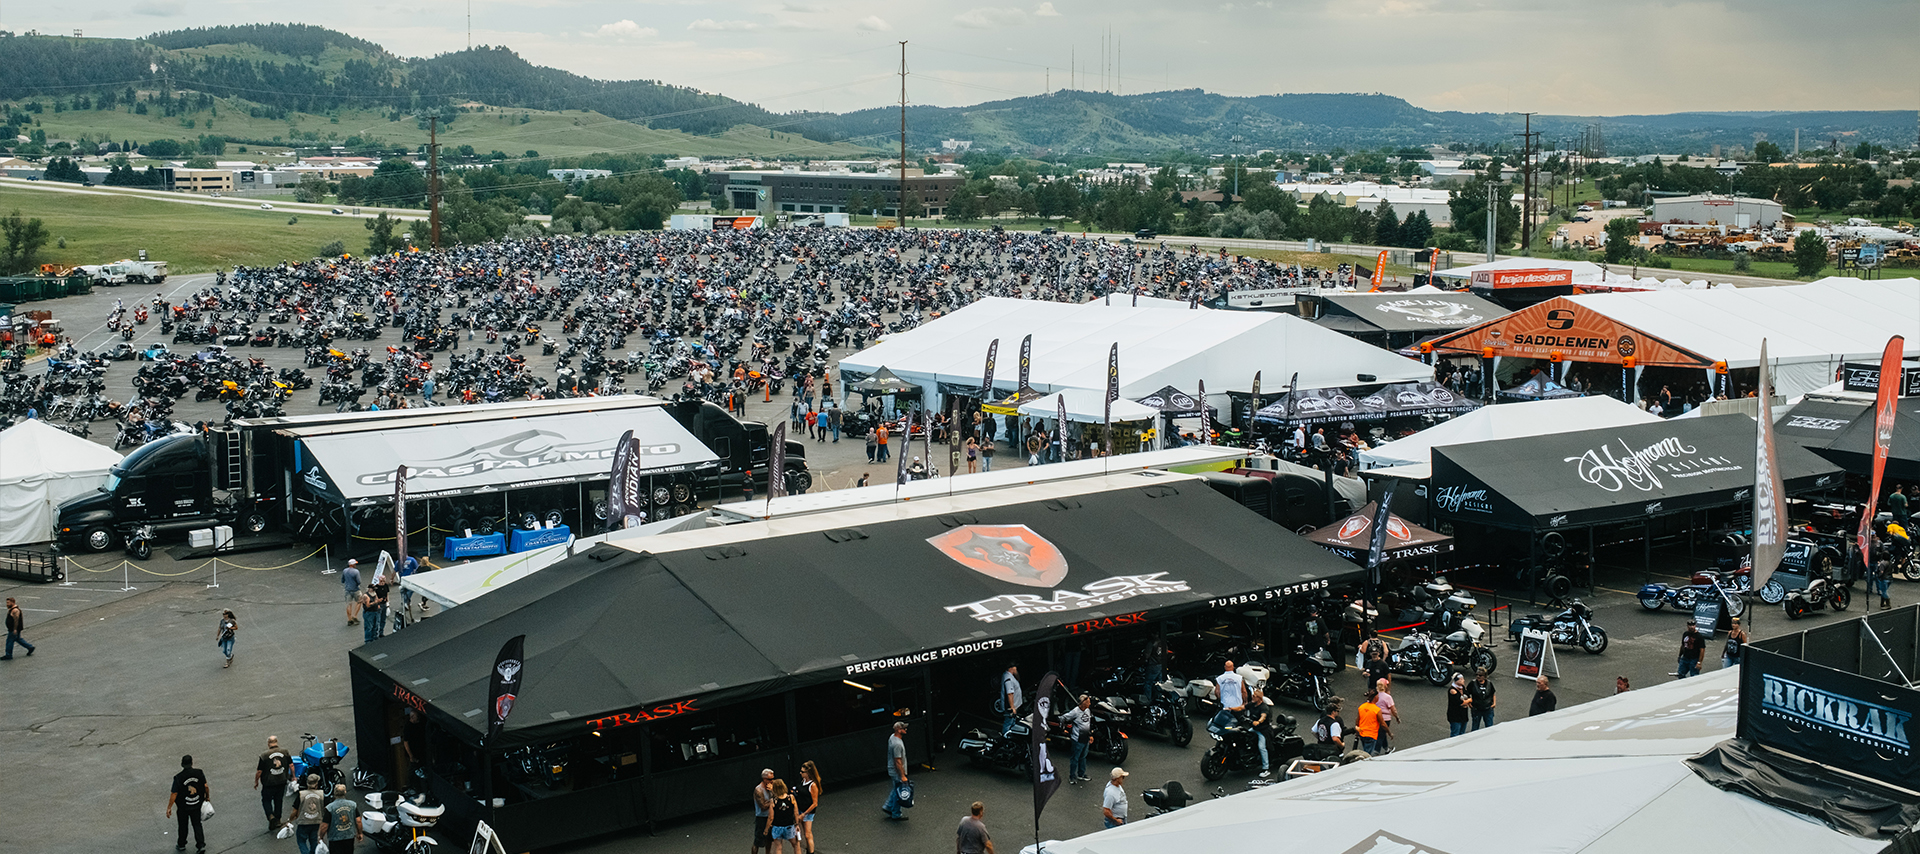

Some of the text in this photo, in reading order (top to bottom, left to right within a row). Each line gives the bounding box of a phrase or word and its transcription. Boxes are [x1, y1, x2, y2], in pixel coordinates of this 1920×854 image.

[1500, 273, 1566, 285] baja designs
[1514, 334, 1610, 349] SADDLEMEN
[984, 369, 993, 391] WILD
[1020, 366, 1028, 389] WILD
[1110, 376, 1118, 399] WILD
[361, 455, 547, 484] COASTAL
[1563, 436, 1697, 492] Hofmann
[1657, 456, 1731, 472] DESIGNS
[629, 451, 639, 508] INDIAN
[1435, 484, 1488, 512] Hofmann
[1464, 501, 1493, 510] DESIGNS
[1393, 545, 1439, 559] TRASK
[945, 572, 1187, 613] TRASK
[977, 583, 1191, 623] TURBO SYSTEMS
[1208, 579, 1329, 608] TURBO SYSTEMS
[1065, 611, 1149, 635] TRASK
[846, 639, 1003, 675] PERFORMANCE PRODUCTS
[392, 682, 428, 713] TRASK
[1762, 678, 1910, 744] RICKRAK
[586, 698, 700, 731] TRASK
[1762, 709, 1823, 732] MOTORCYCLE
[1839, 732, 1909, 756] NECESSITIES
